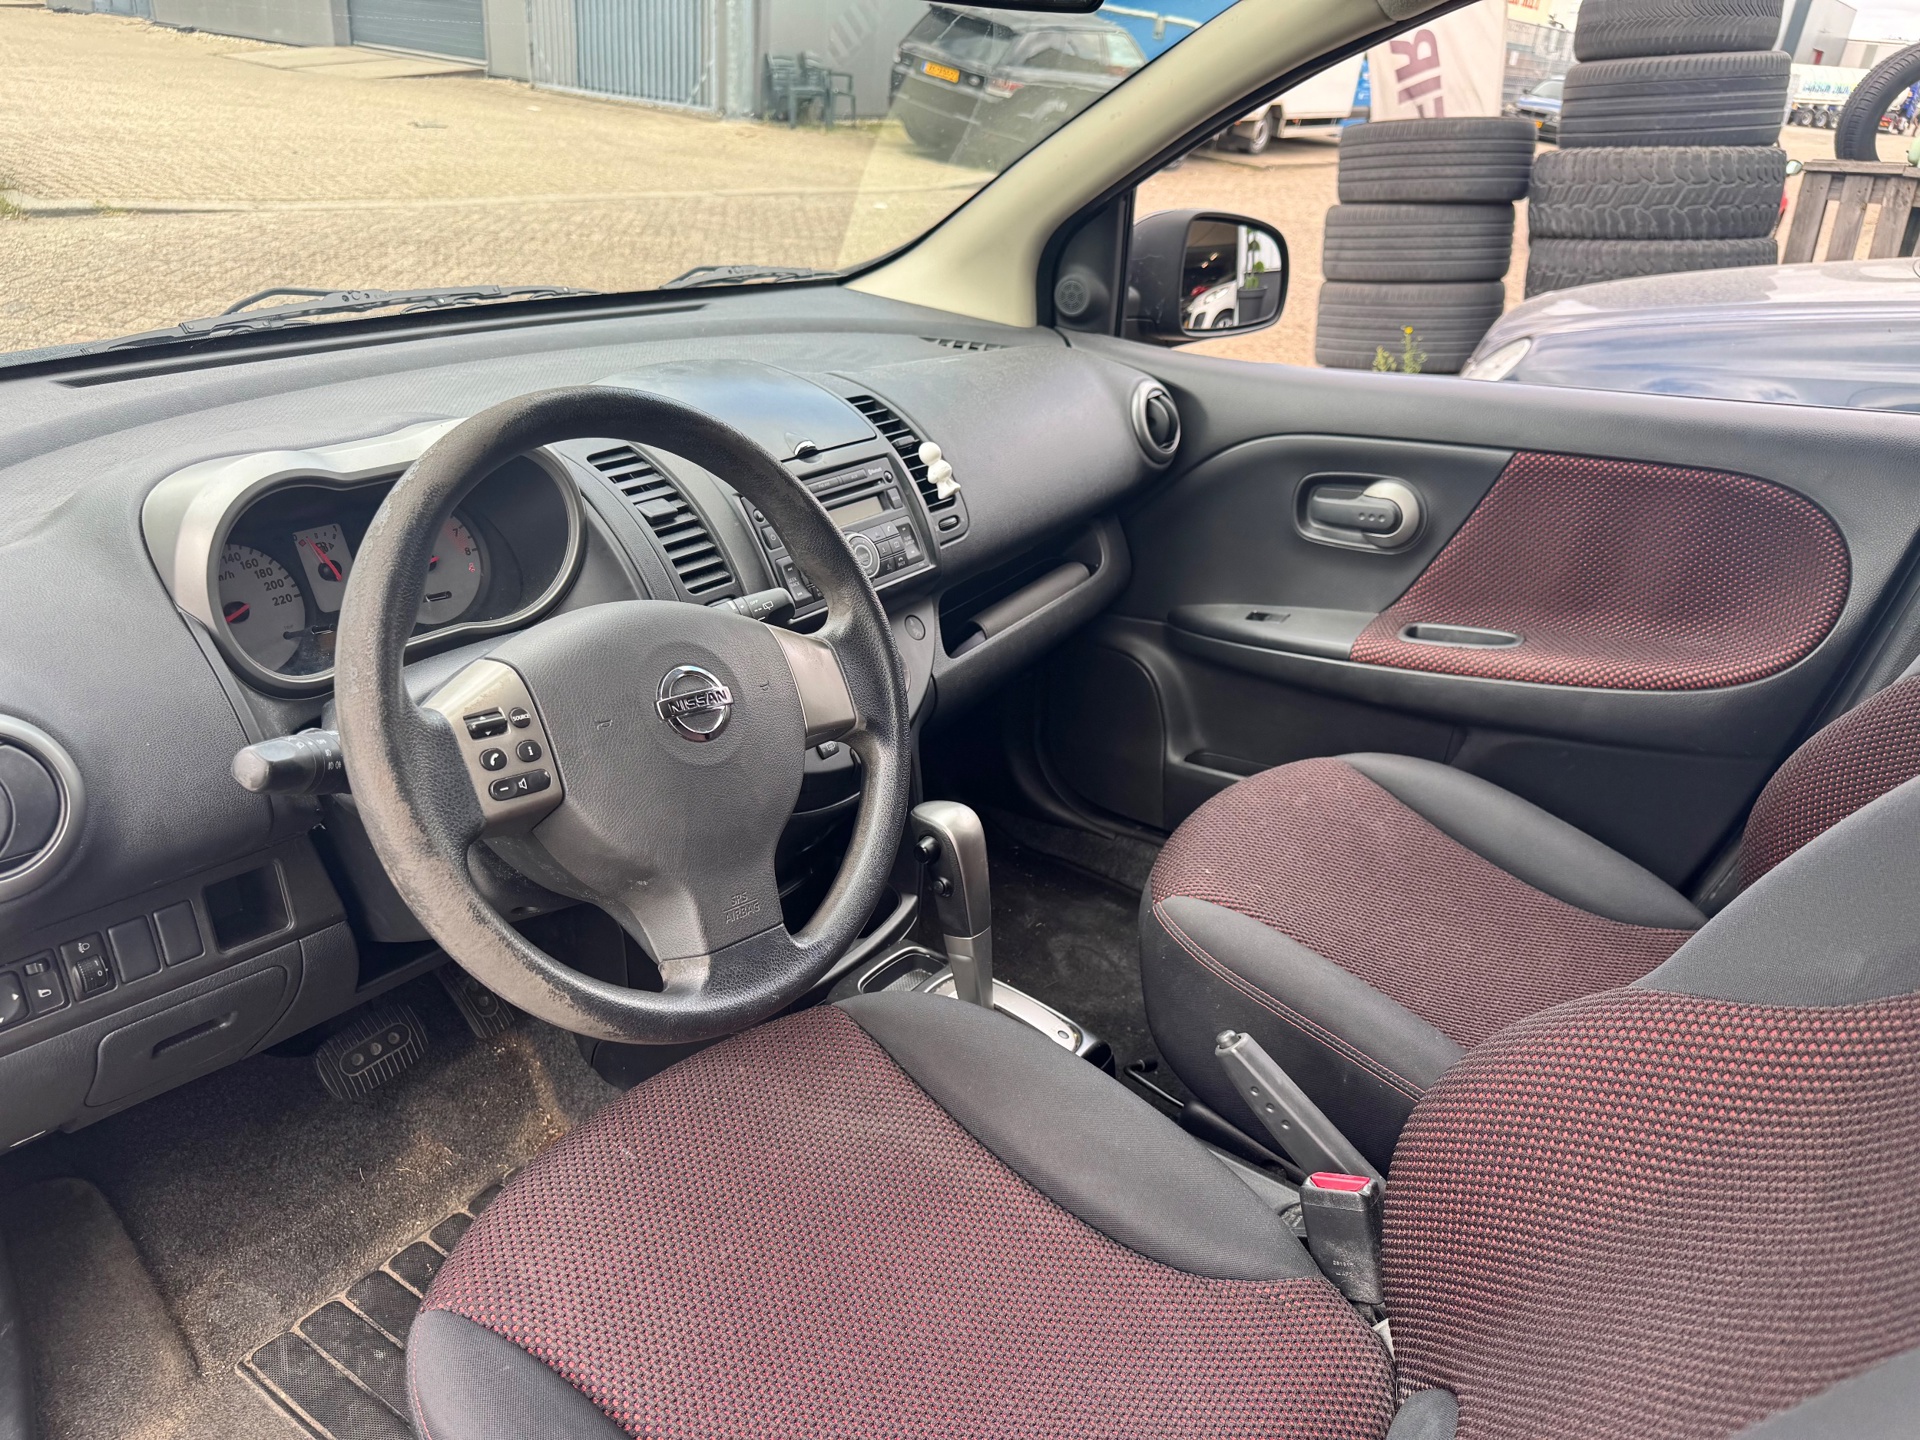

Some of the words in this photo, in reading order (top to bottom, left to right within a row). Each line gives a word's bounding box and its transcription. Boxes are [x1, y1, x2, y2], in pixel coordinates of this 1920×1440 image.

[452, 528, 459, 537] 7
[464, 547, 472, 556] 8
[222, 552, 241, 564] 140
[240, 558, 259, 570] 160
[254, 567, 274, 579] 180
[264, 579, 285, 591] 200
[272, 594, 293, 606] 220
[667, 688, 729, 714] NISSAN
[725, 901, 760, 924] AIRBAG
